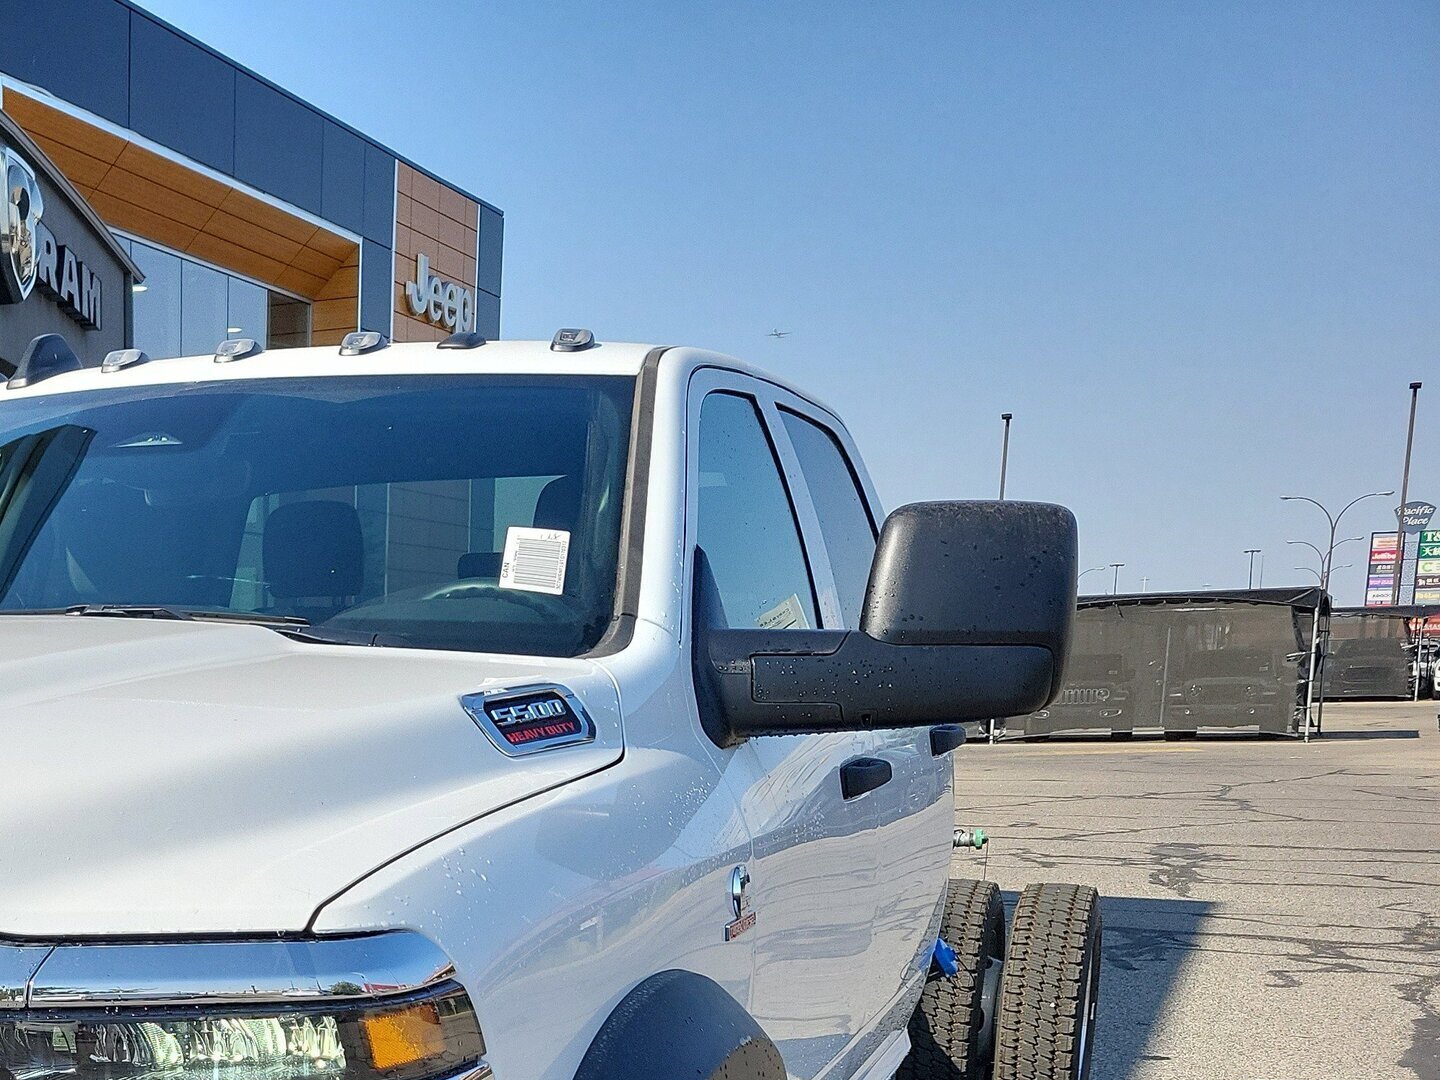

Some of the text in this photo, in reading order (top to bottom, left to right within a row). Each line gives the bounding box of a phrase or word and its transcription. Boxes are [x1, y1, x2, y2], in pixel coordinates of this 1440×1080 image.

[37, 222, 103, 331] RAM
[405, 253, 472, 333] Jeep
[1402, 516, 1429, 526] Place
[502, 562, 510, 578] CAN
[490, 699, 567, 727] 5500
[506, 722, 576, 743] HEAVY DUTY
